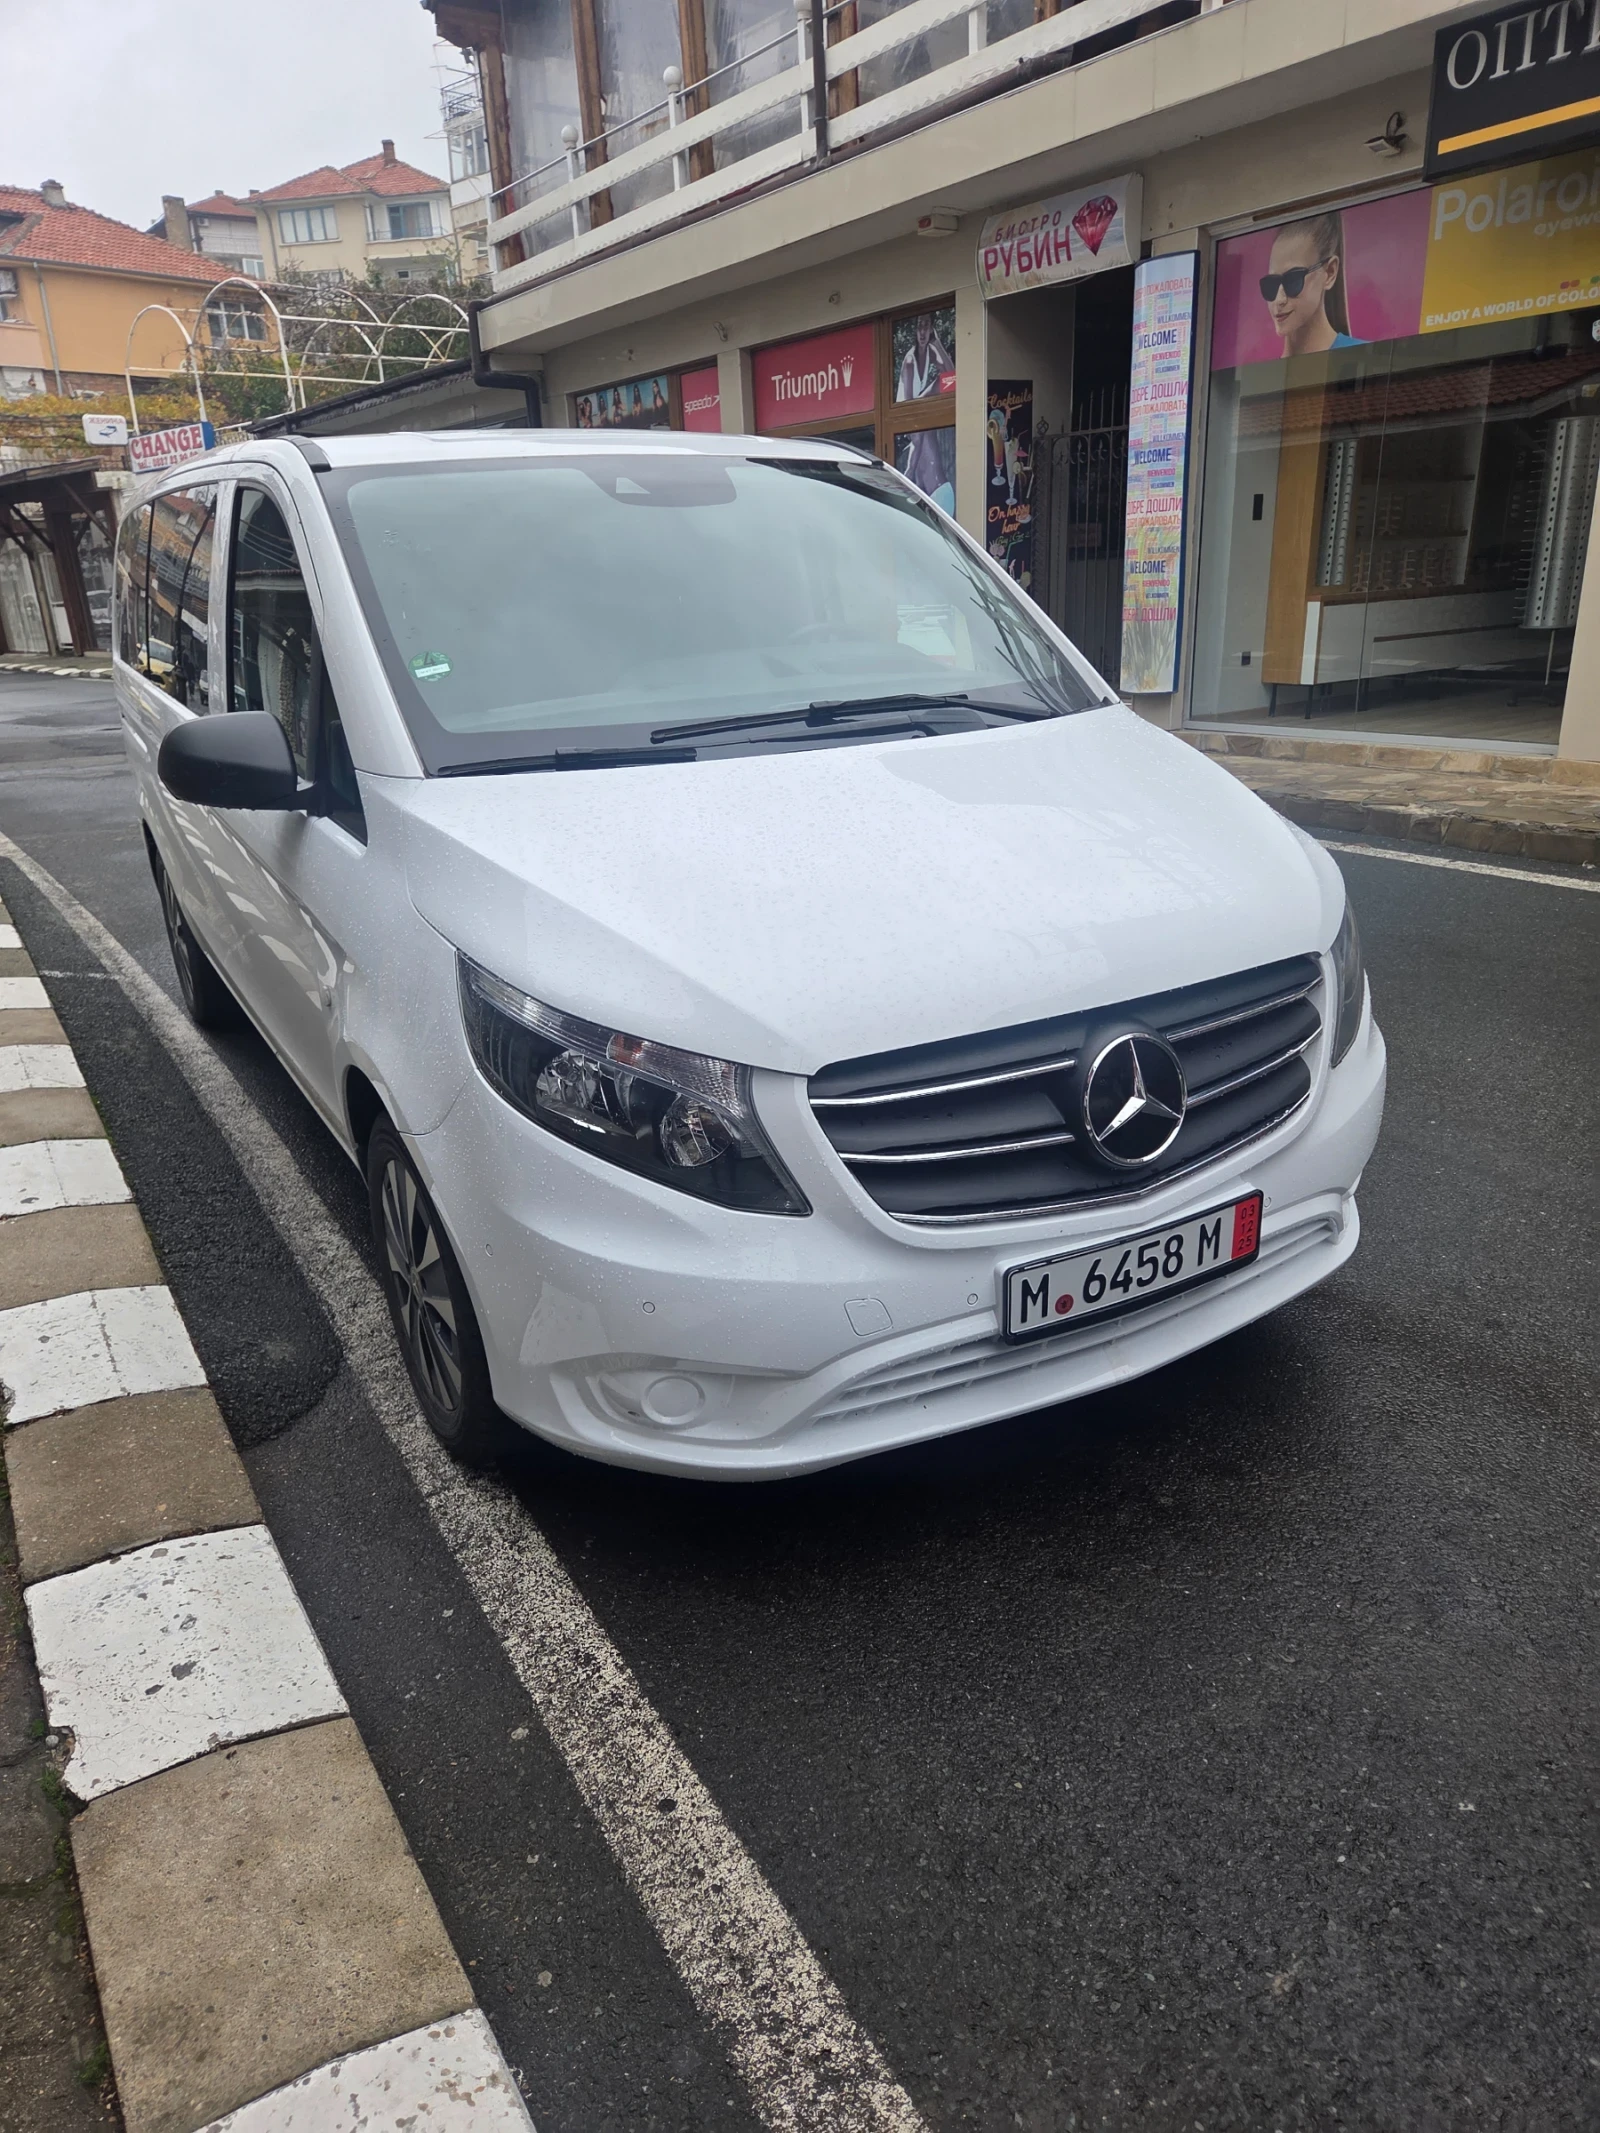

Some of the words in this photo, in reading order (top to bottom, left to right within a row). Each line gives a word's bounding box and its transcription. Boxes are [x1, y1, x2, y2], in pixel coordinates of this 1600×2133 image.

[1446, 0, 1600, 90] ОПТ
[995, 210, 1062, 242] БИСТРО
[983, 225, 1073, 281] РУБИН
[1157, 312, 1192, 324] WILLKOMMEN
[1426, 308, 1469, 327] ENJOY
[1471, 305, 1482, 319] A
[1483, 297, 1533, 316] WORLD
[1536, 294, 1556, 309] OF
[1138, 329, 1177, 349] WELCOME
[771, 363, 839, 401] Triumph
[1150, 381, 1188, 401] ДОШЛИ
[684, 395, 713, 415] speedo
[131, 426, 203, 459] CHANGE
[1134, 448, 1172, 464] WELCOME
[988, 506, 1006, 523] On
[1146, 498, 1182, 514] ДОШЛИ
[1130, 560, 1166, 574] WELCOME
[1141, 607, 1176, 622] ДОШЛИ
[1240, 1204, 1255, 1220] 03
[1239, 1220, 1254, 1235] 12
[1237, 1235, 1253, 1252] 25
[1020, 1273, 1049, 1324] M
[1082, 1234, 1184, 1304] 6458
[1197, 1217, 1222, 1267] M
